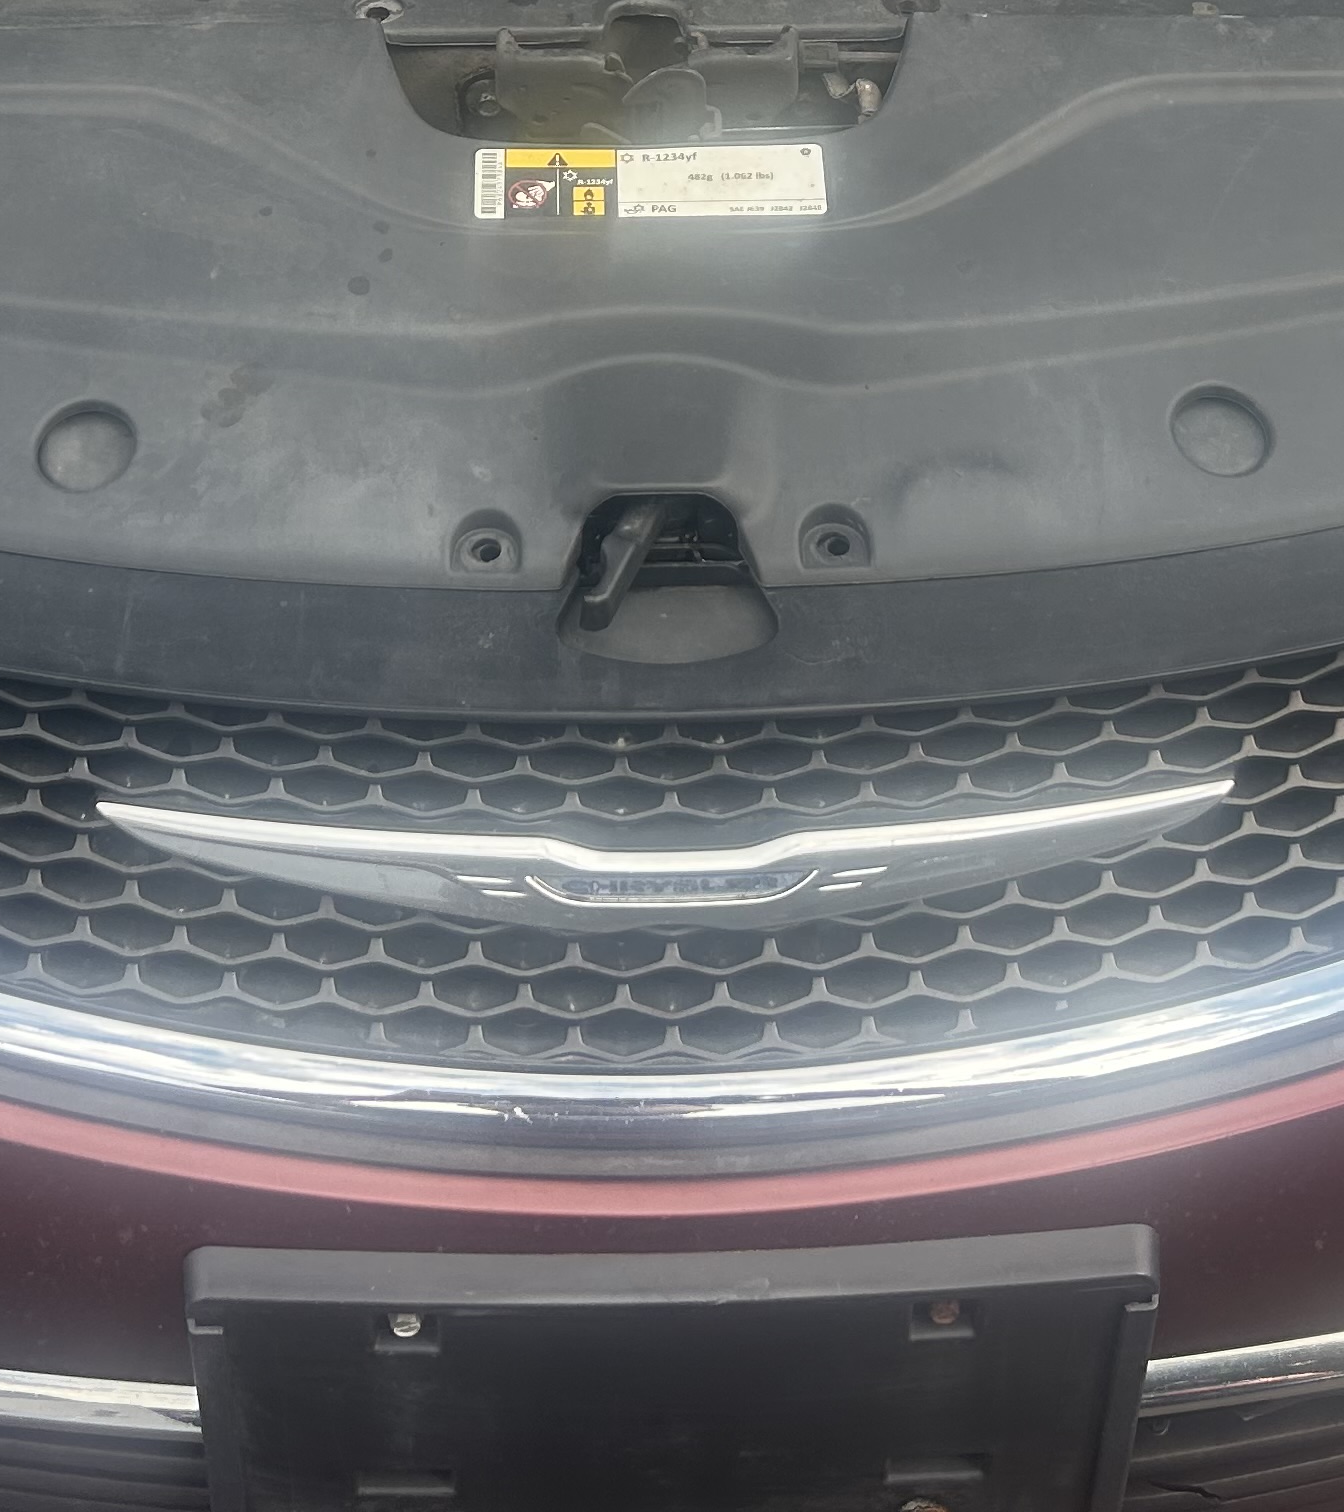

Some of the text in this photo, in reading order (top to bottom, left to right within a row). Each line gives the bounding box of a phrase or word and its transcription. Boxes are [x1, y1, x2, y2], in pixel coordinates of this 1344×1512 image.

[641, 152, 698, 163] R-1234yf
[755, 171, 774, 181] lbs)
[651, 204, 678, 213] PAG
[561, 876, 779, 894] CHRYSLER
